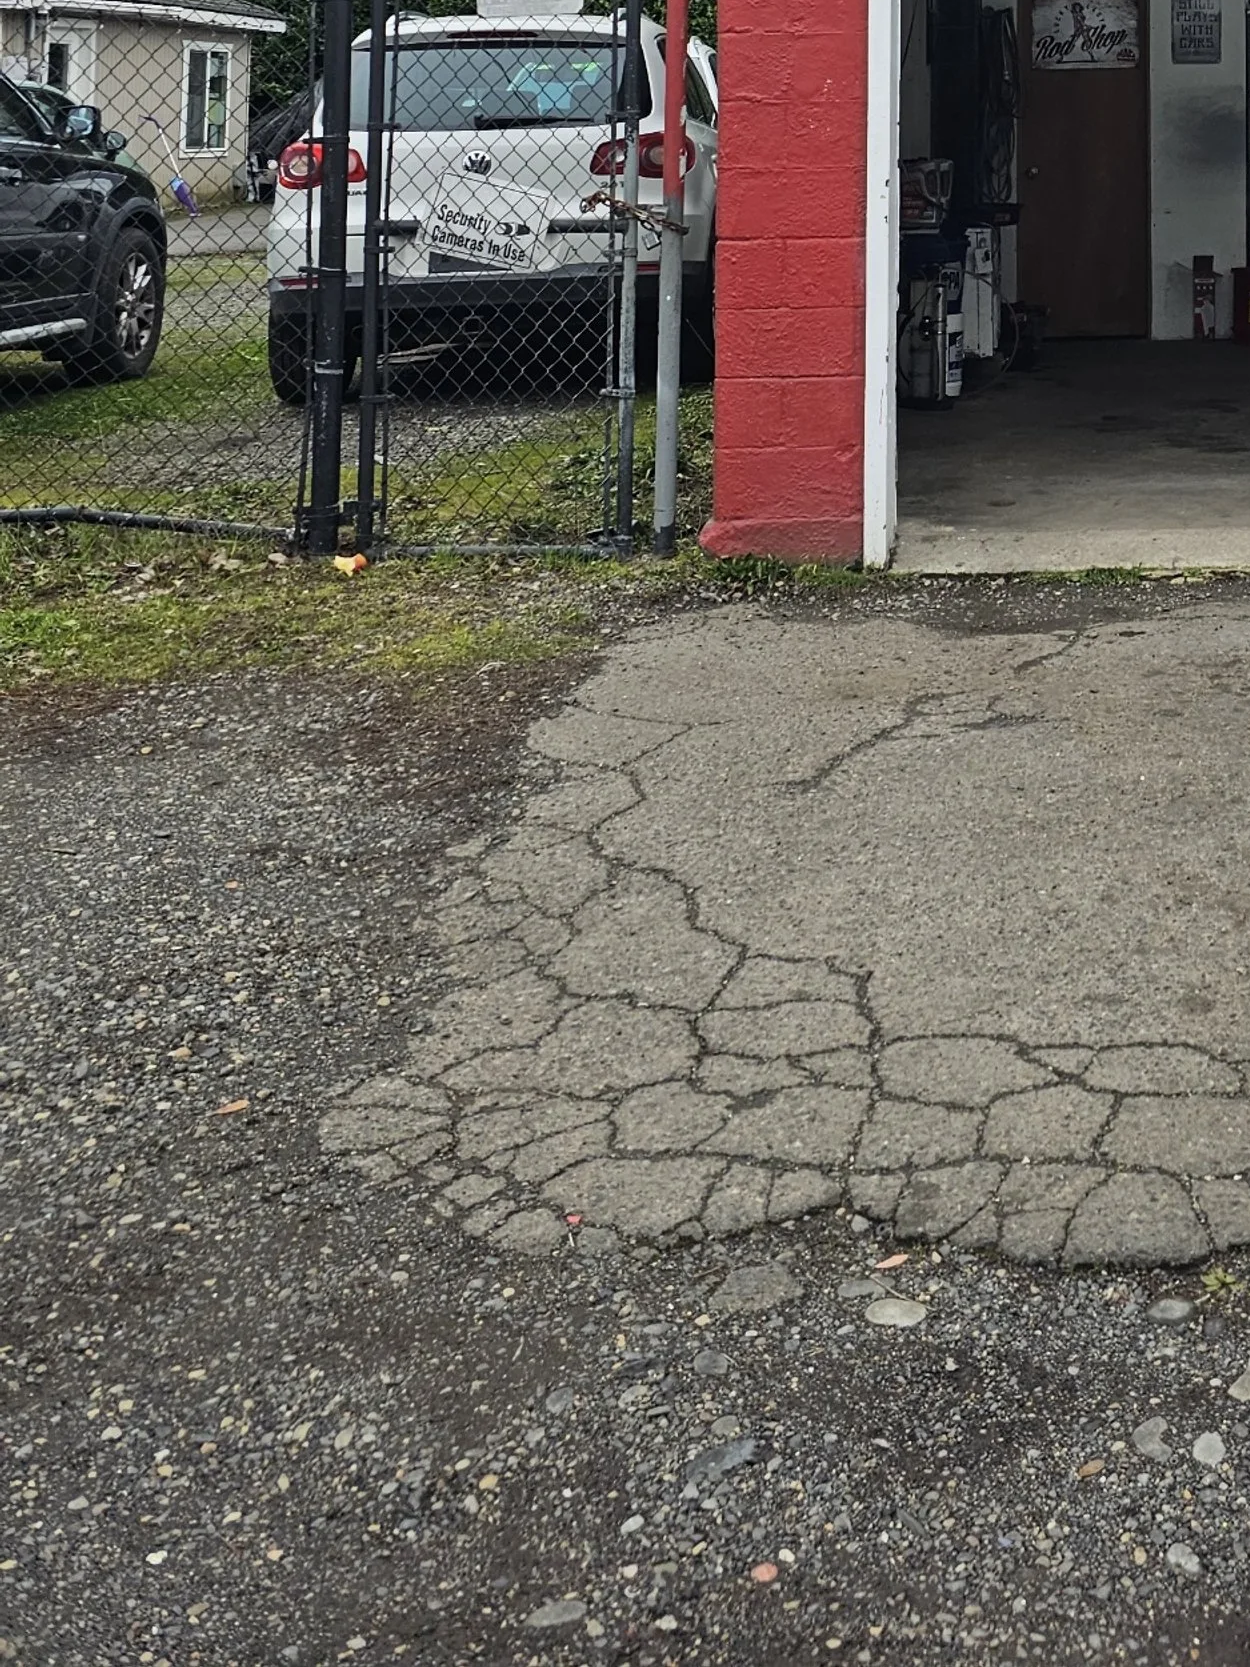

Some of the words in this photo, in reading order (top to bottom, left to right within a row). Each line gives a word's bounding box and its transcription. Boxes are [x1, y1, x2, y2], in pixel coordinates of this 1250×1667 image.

[1176, 11, 1218, 22] PLAYS
[1181, 24, 1213, 35] WITH
[1034, 30, 1076, 61] Rod
[1081, 24, 1128, 55] Shop
[1179, 37, 1214, 48] CARS
[437, 203, 492, 235] Security
[430, 224, 485, 254] Cameras
[487, 239, 501, 256] In
[503, 243, 526, 263] Use
